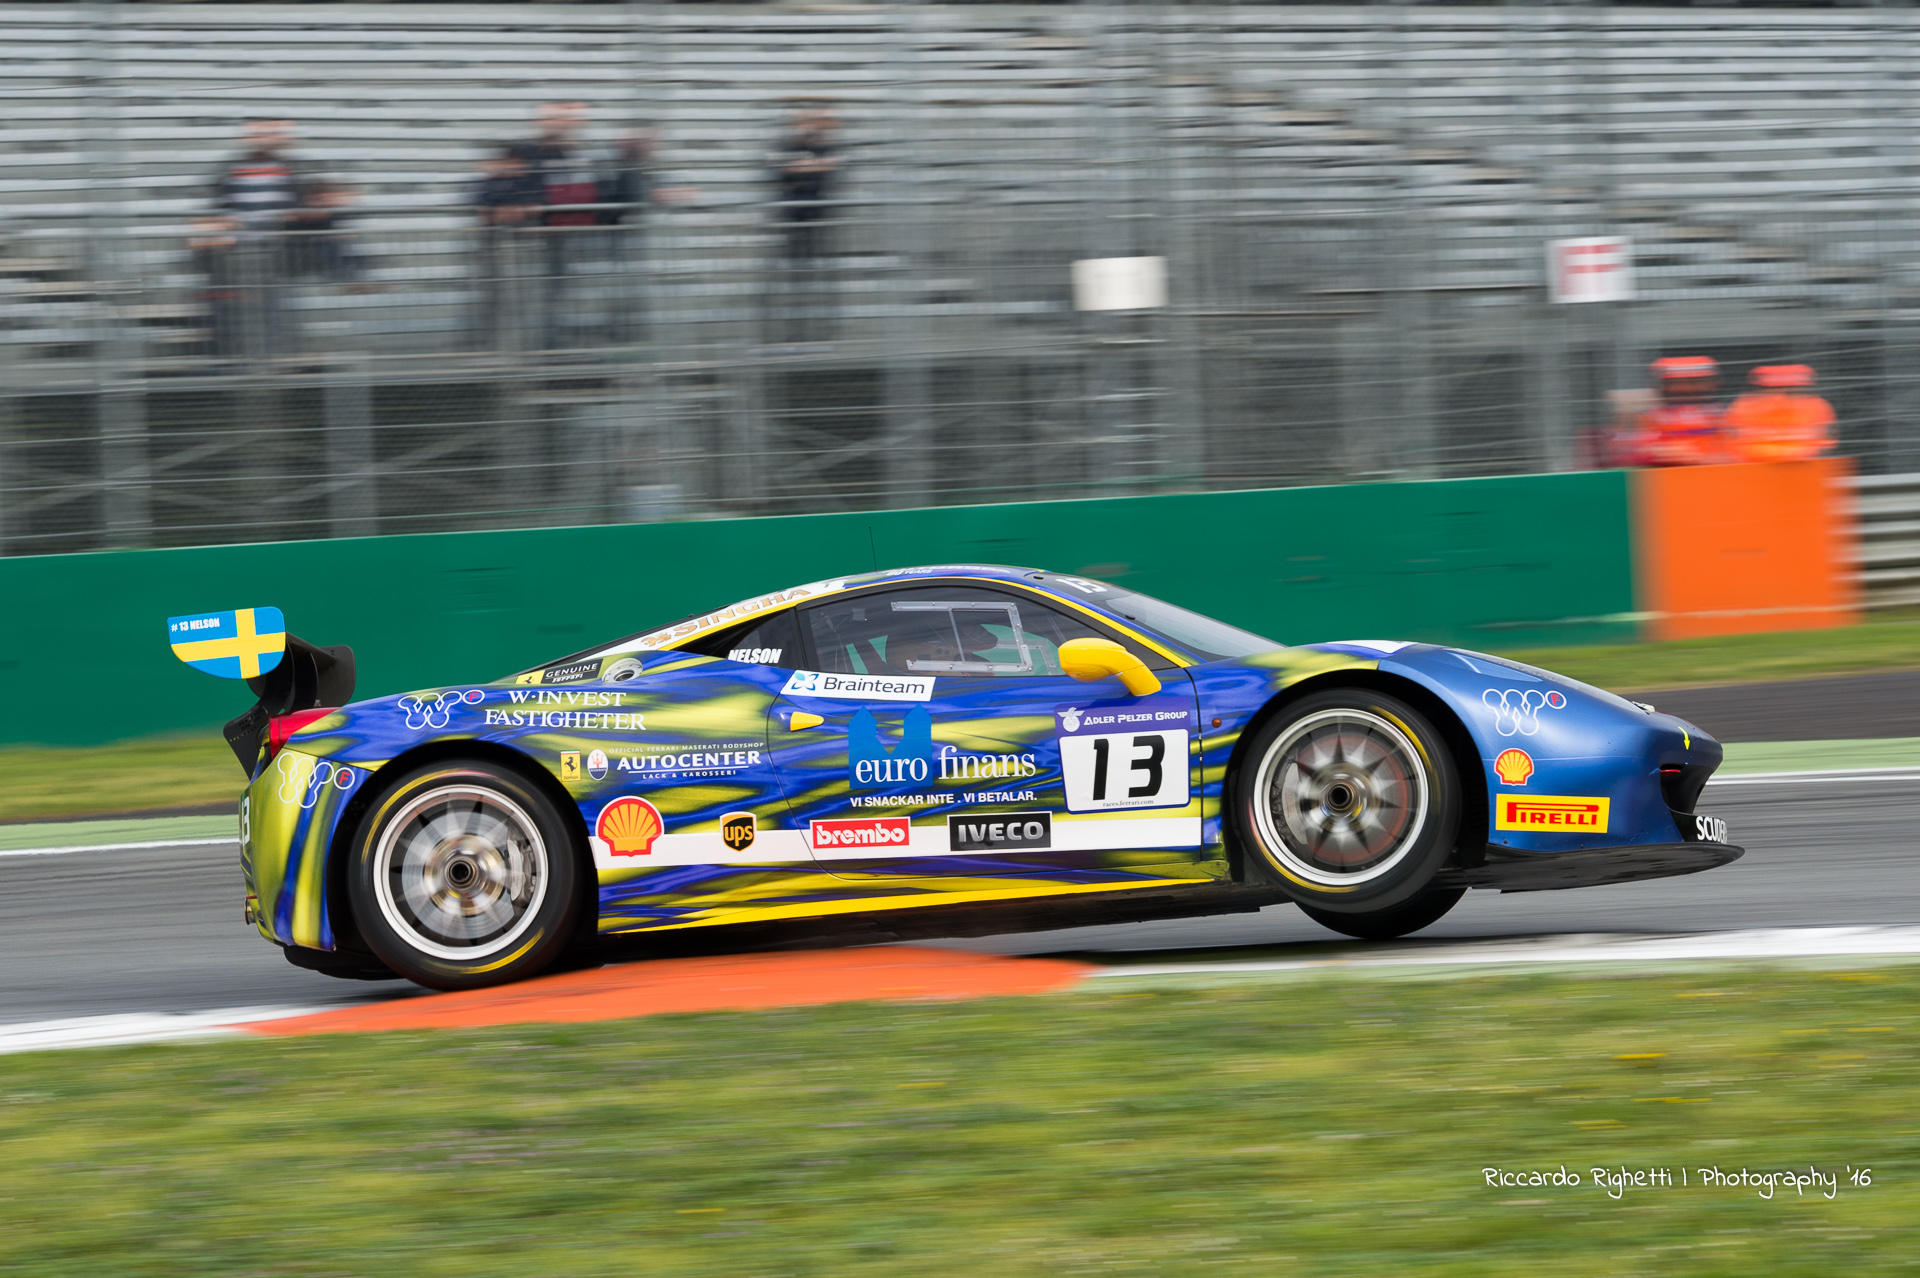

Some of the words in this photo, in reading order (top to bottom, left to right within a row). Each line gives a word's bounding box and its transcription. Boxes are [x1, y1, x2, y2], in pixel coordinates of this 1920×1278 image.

[673, 588, 812, 637] SINGHA
[179, 620, 189, 631] 13
[190, 617, 220, 630] NELSON
[727, 648, 783, 664] NELSON
[545, 663, 598, 678] GENUINE
[823, 676, 926, 695] Brainteam
[484, 708, 647, 730] FASTIGHETER
[1083, 716, 1115, 726] ADLER
[1117, 713, 1153, 724] PELZER
[1155, 711, 1188, 721] GROUP
[682, 743, 720, 751] MASERATI
[617, 751, 762, 771] AUTOCENTER
[855, 756, 928, 784] euro
[938, 745, 1037, 781] finans
[1092, 734, 1166, 801] 13
[683, 770, 737, 778] KAROSSERI
[850, 797, 862, 808] VI
[865, 795, 924, 807] SNACKAR
[927, 793, 954, 805] INTE
[963, 792, 976, 803] VI
[978, 791, 1037, 802] BETALAR.
[1102, 800, 1155, 808] races.ferrari.com
[1506, 801, 1600, 826] PIRELLI
[724, 825, 754, 847] ups
[816, 823, 906, 846] brembo
[958, 821, 1044, 843] IVECO
